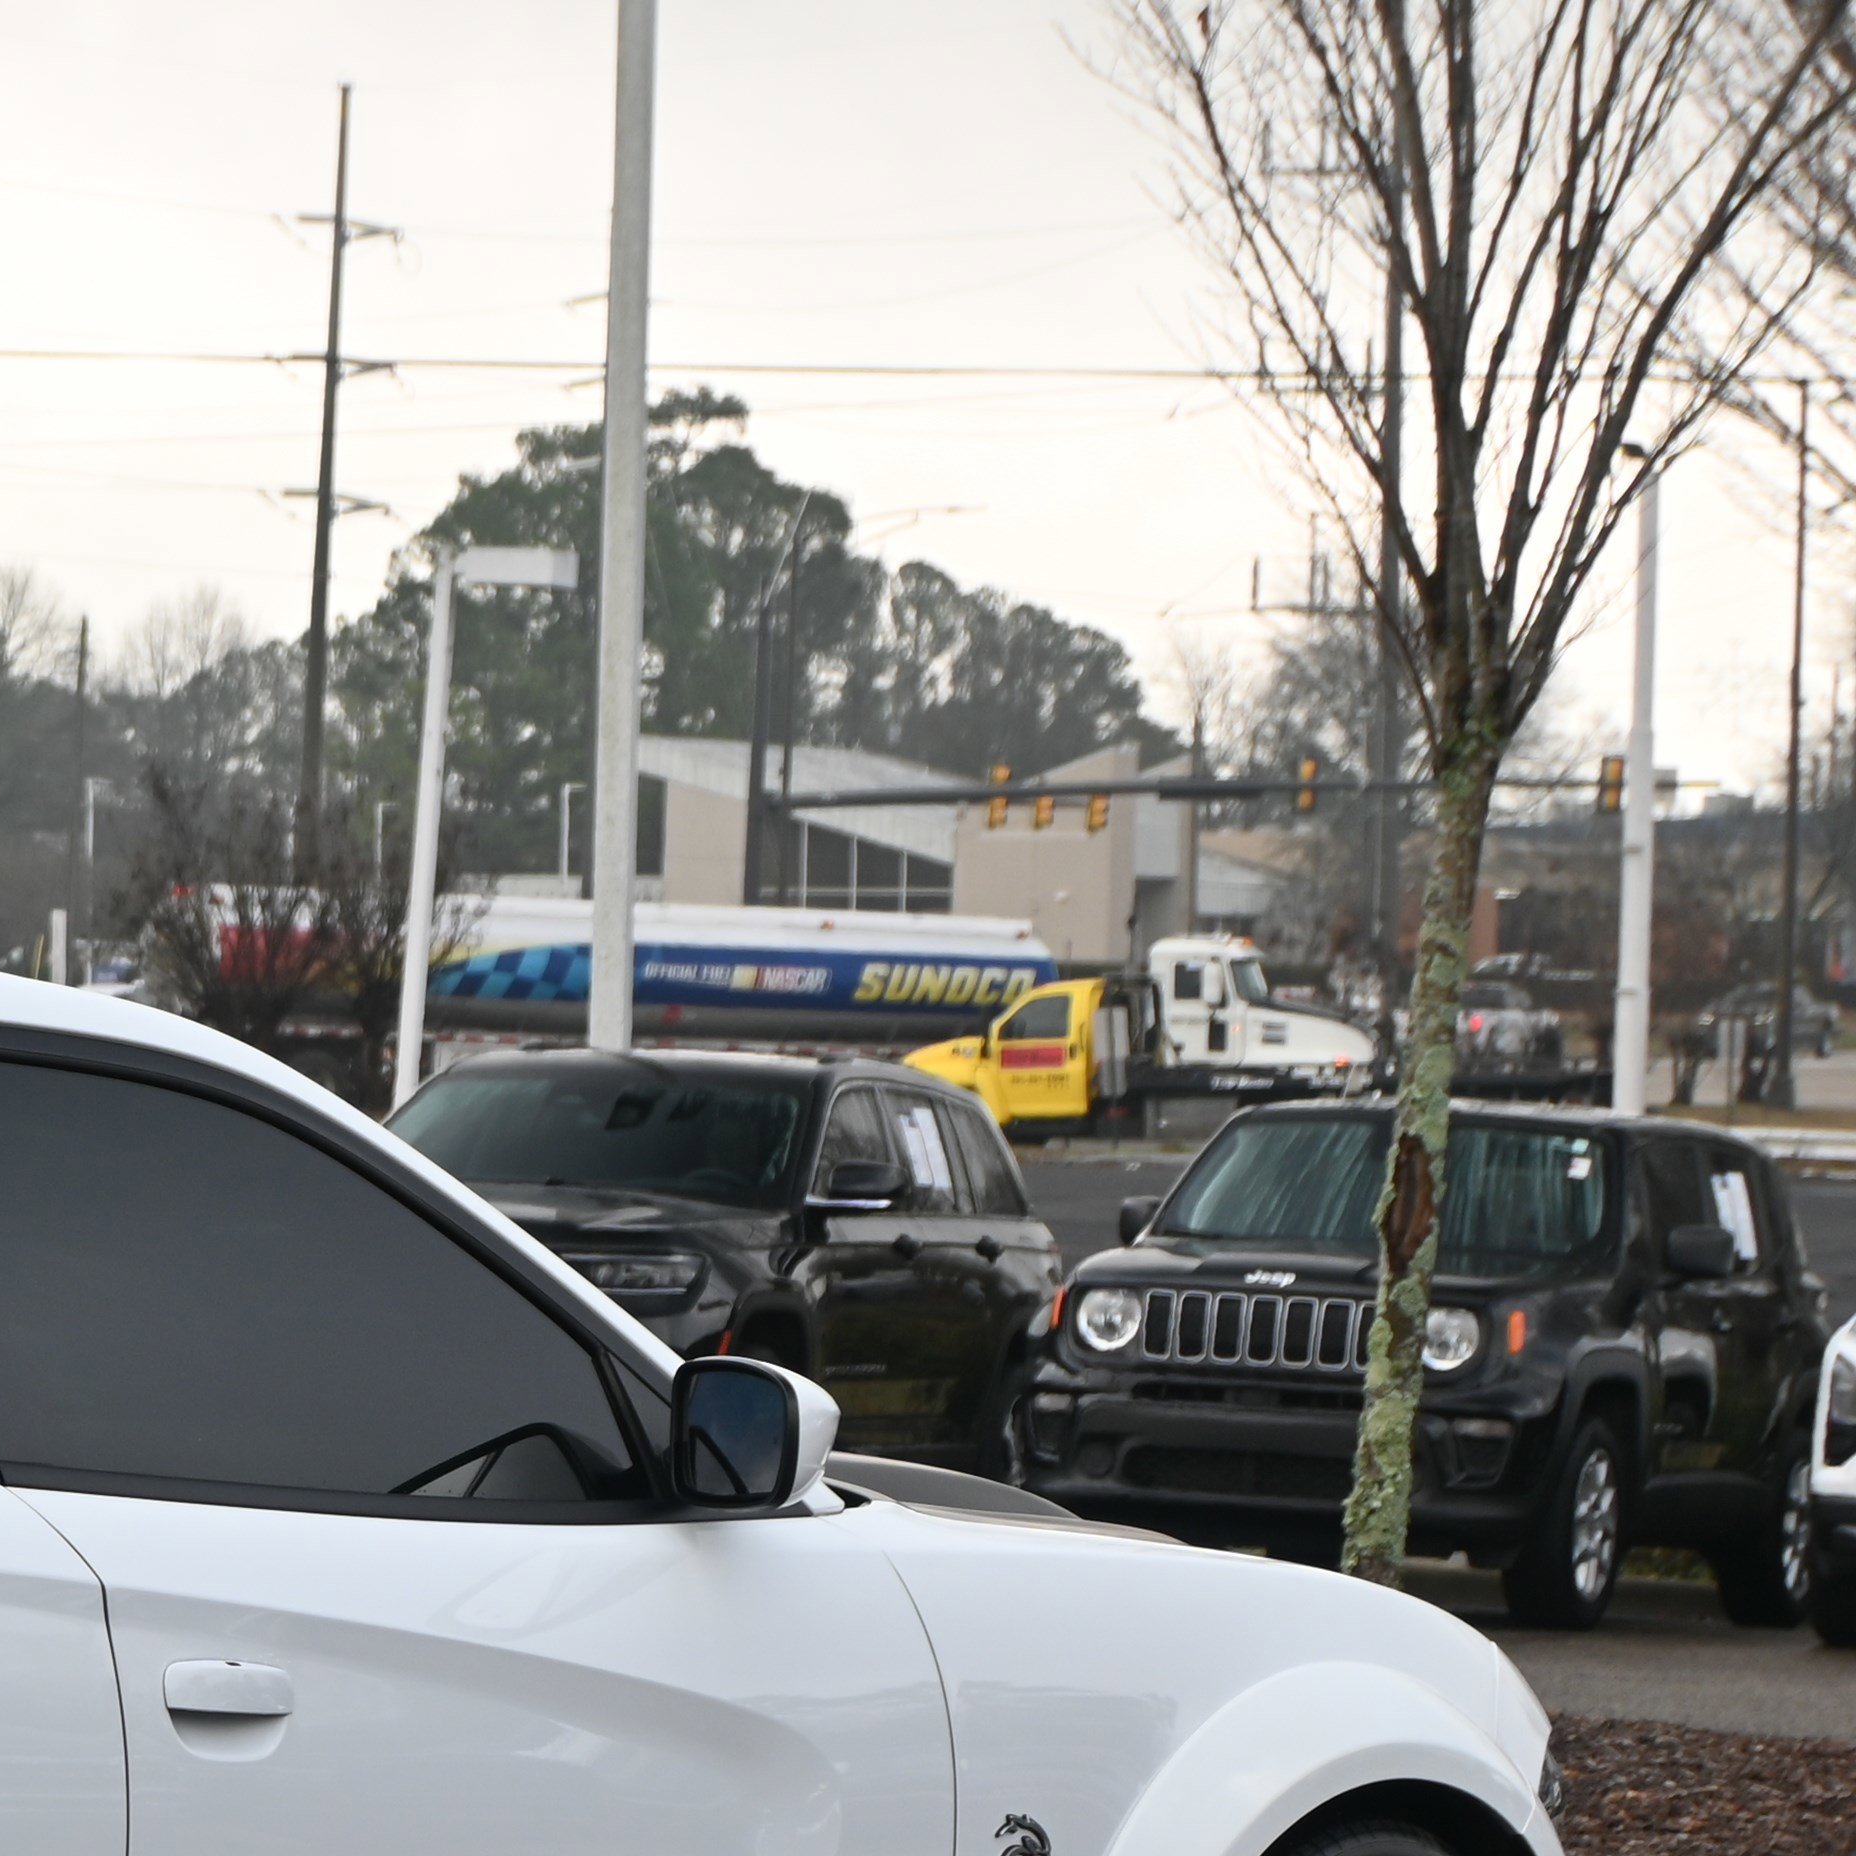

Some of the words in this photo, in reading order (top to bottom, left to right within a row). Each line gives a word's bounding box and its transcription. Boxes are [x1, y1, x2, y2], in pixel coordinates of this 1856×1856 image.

[763, 967, 829, 993] NASCAR
[854, 962, 1038, 1006] SUNOCO
[1244, 1269, 1296, 1288] Jeep
